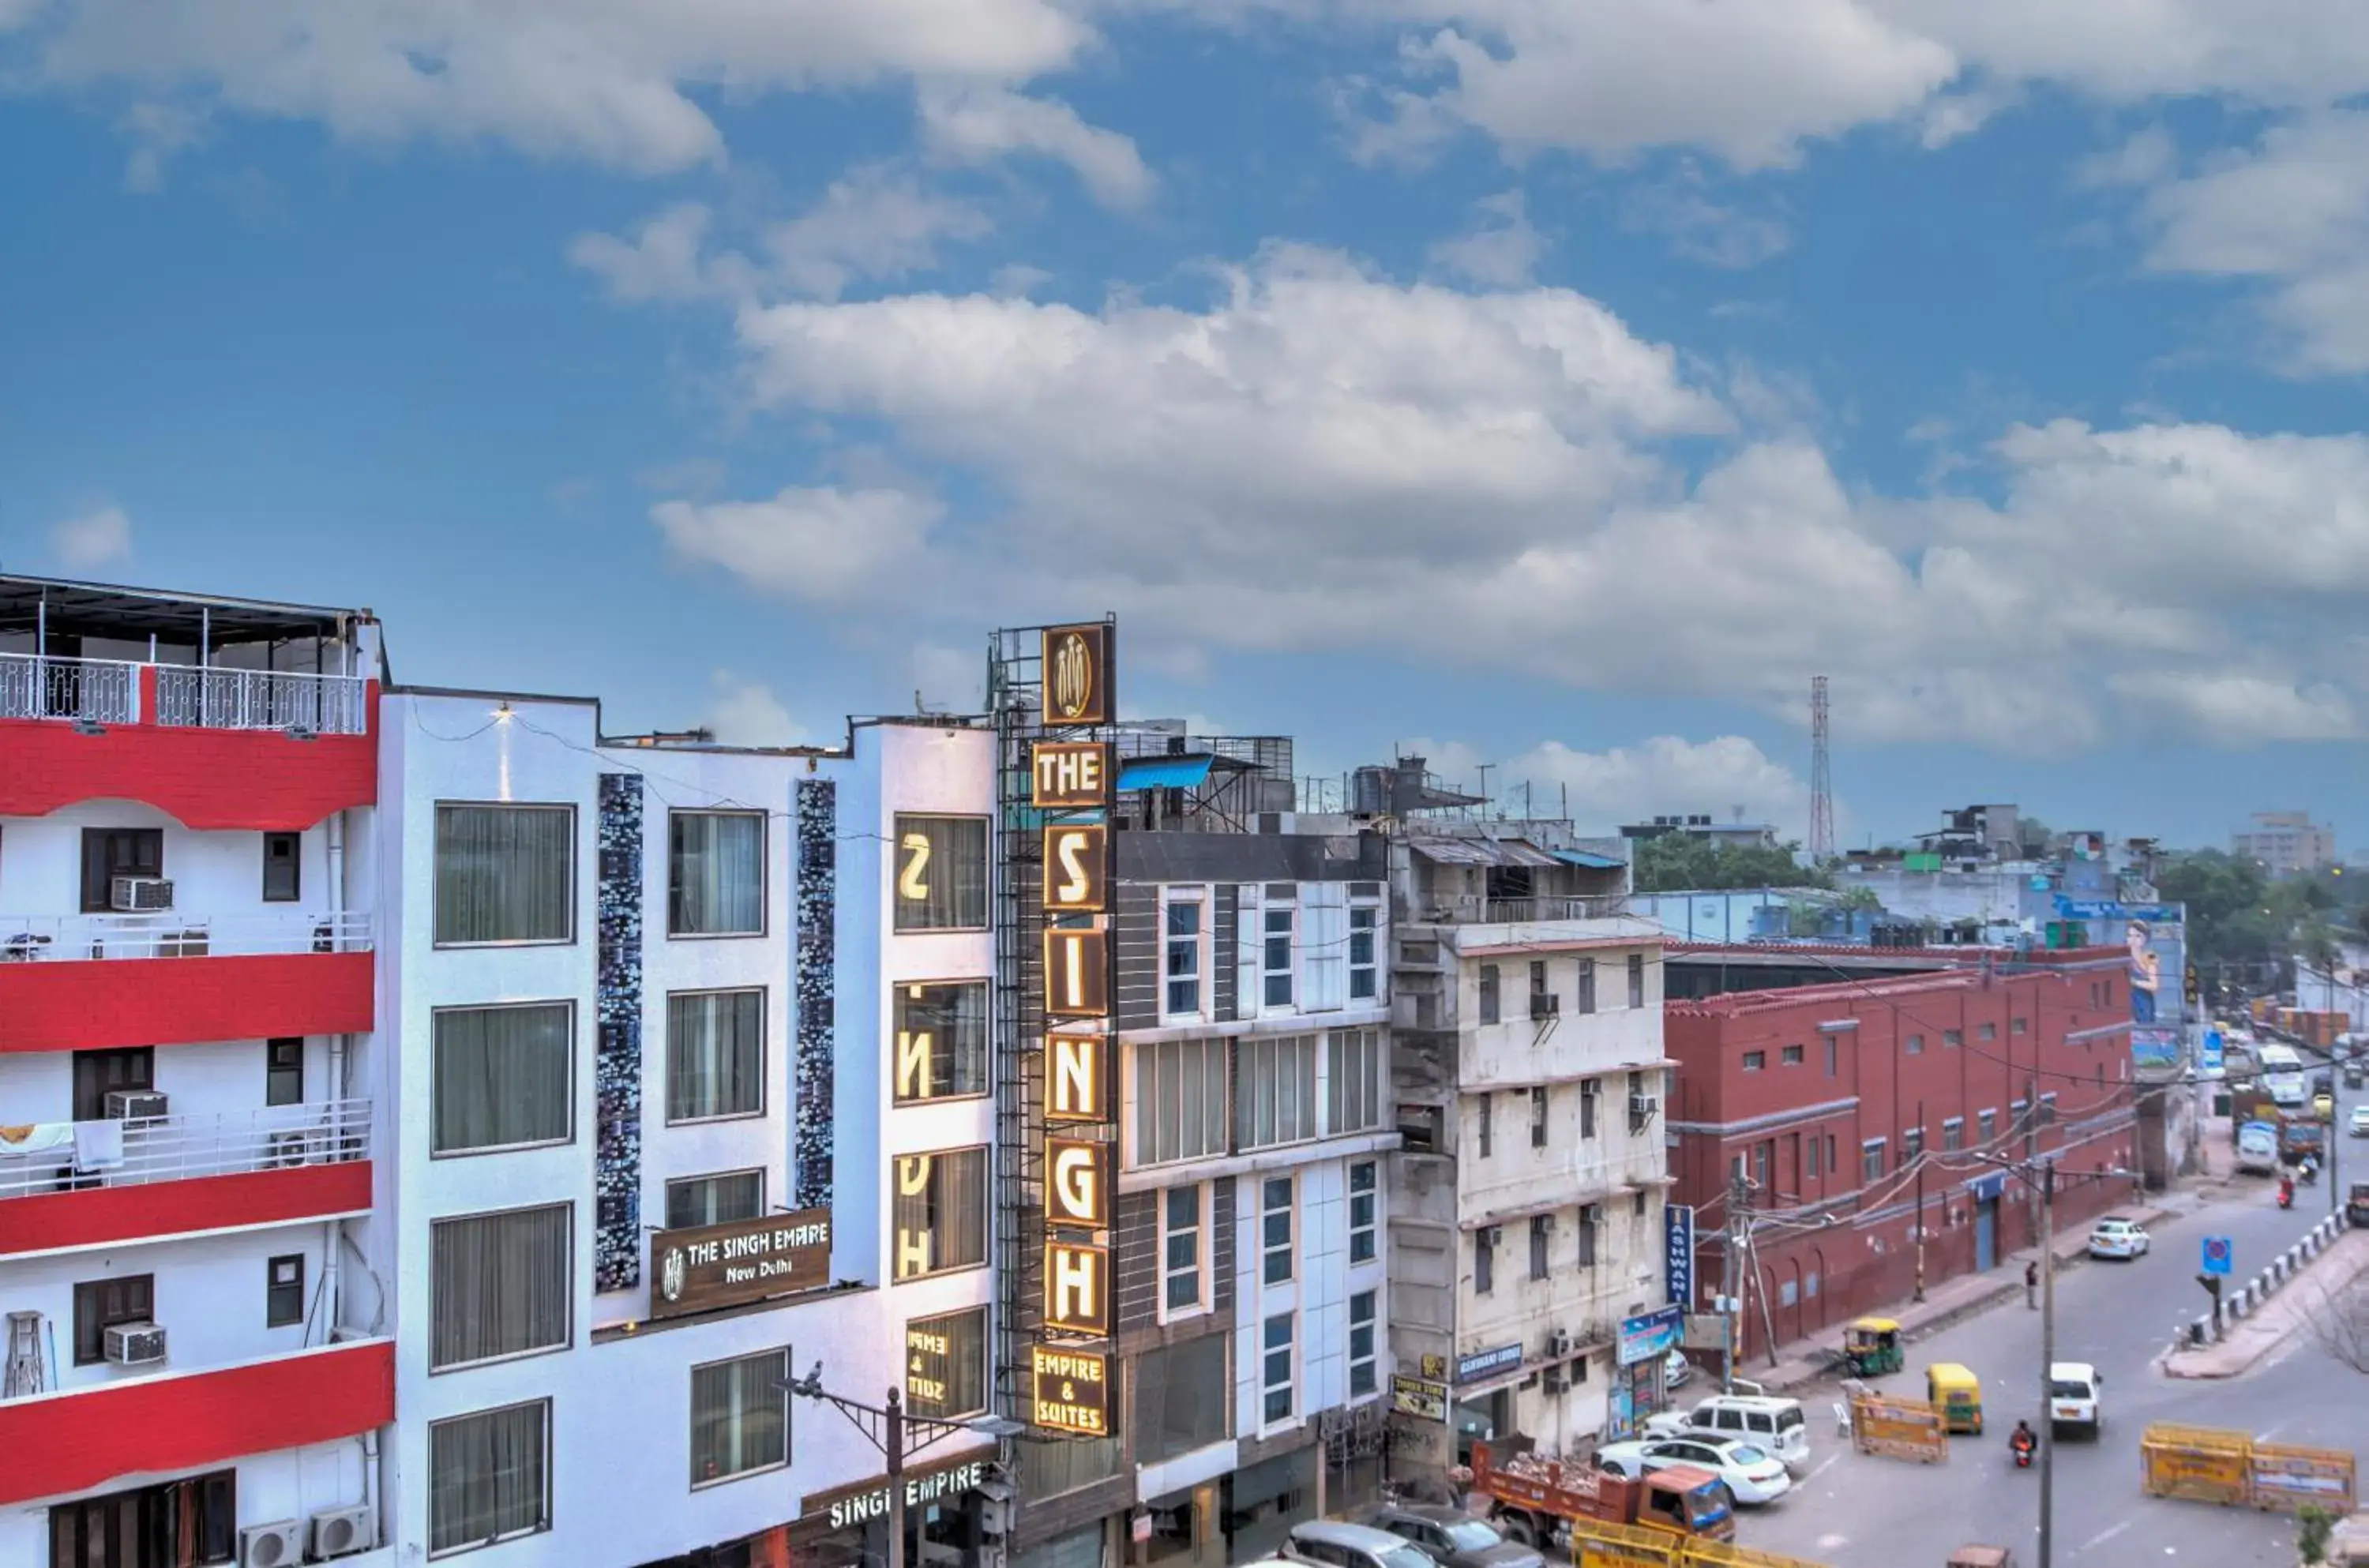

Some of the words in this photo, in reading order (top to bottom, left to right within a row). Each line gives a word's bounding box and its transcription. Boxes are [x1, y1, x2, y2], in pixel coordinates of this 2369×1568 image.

[1038, 752, 1098, 796] THE
[689, 1240, 719, 1266] THE
[723, 1232, 769, 1259] SINGH
[775, 1223, 828, 1250] EMPIRE
[726, 1265, 756, 1284] New
[760, 1258, 792, 1277] Delhi
[1669, 1225, 1688, 1302] ASHWANI
[1036, 1353, 1102, 1382] EMPIRE
[1061, 1381, 1075, 1401] &
[1039, 1401, 1102, 1430] SUITES
[906, 1461, 982, 1506] EMPIRE
